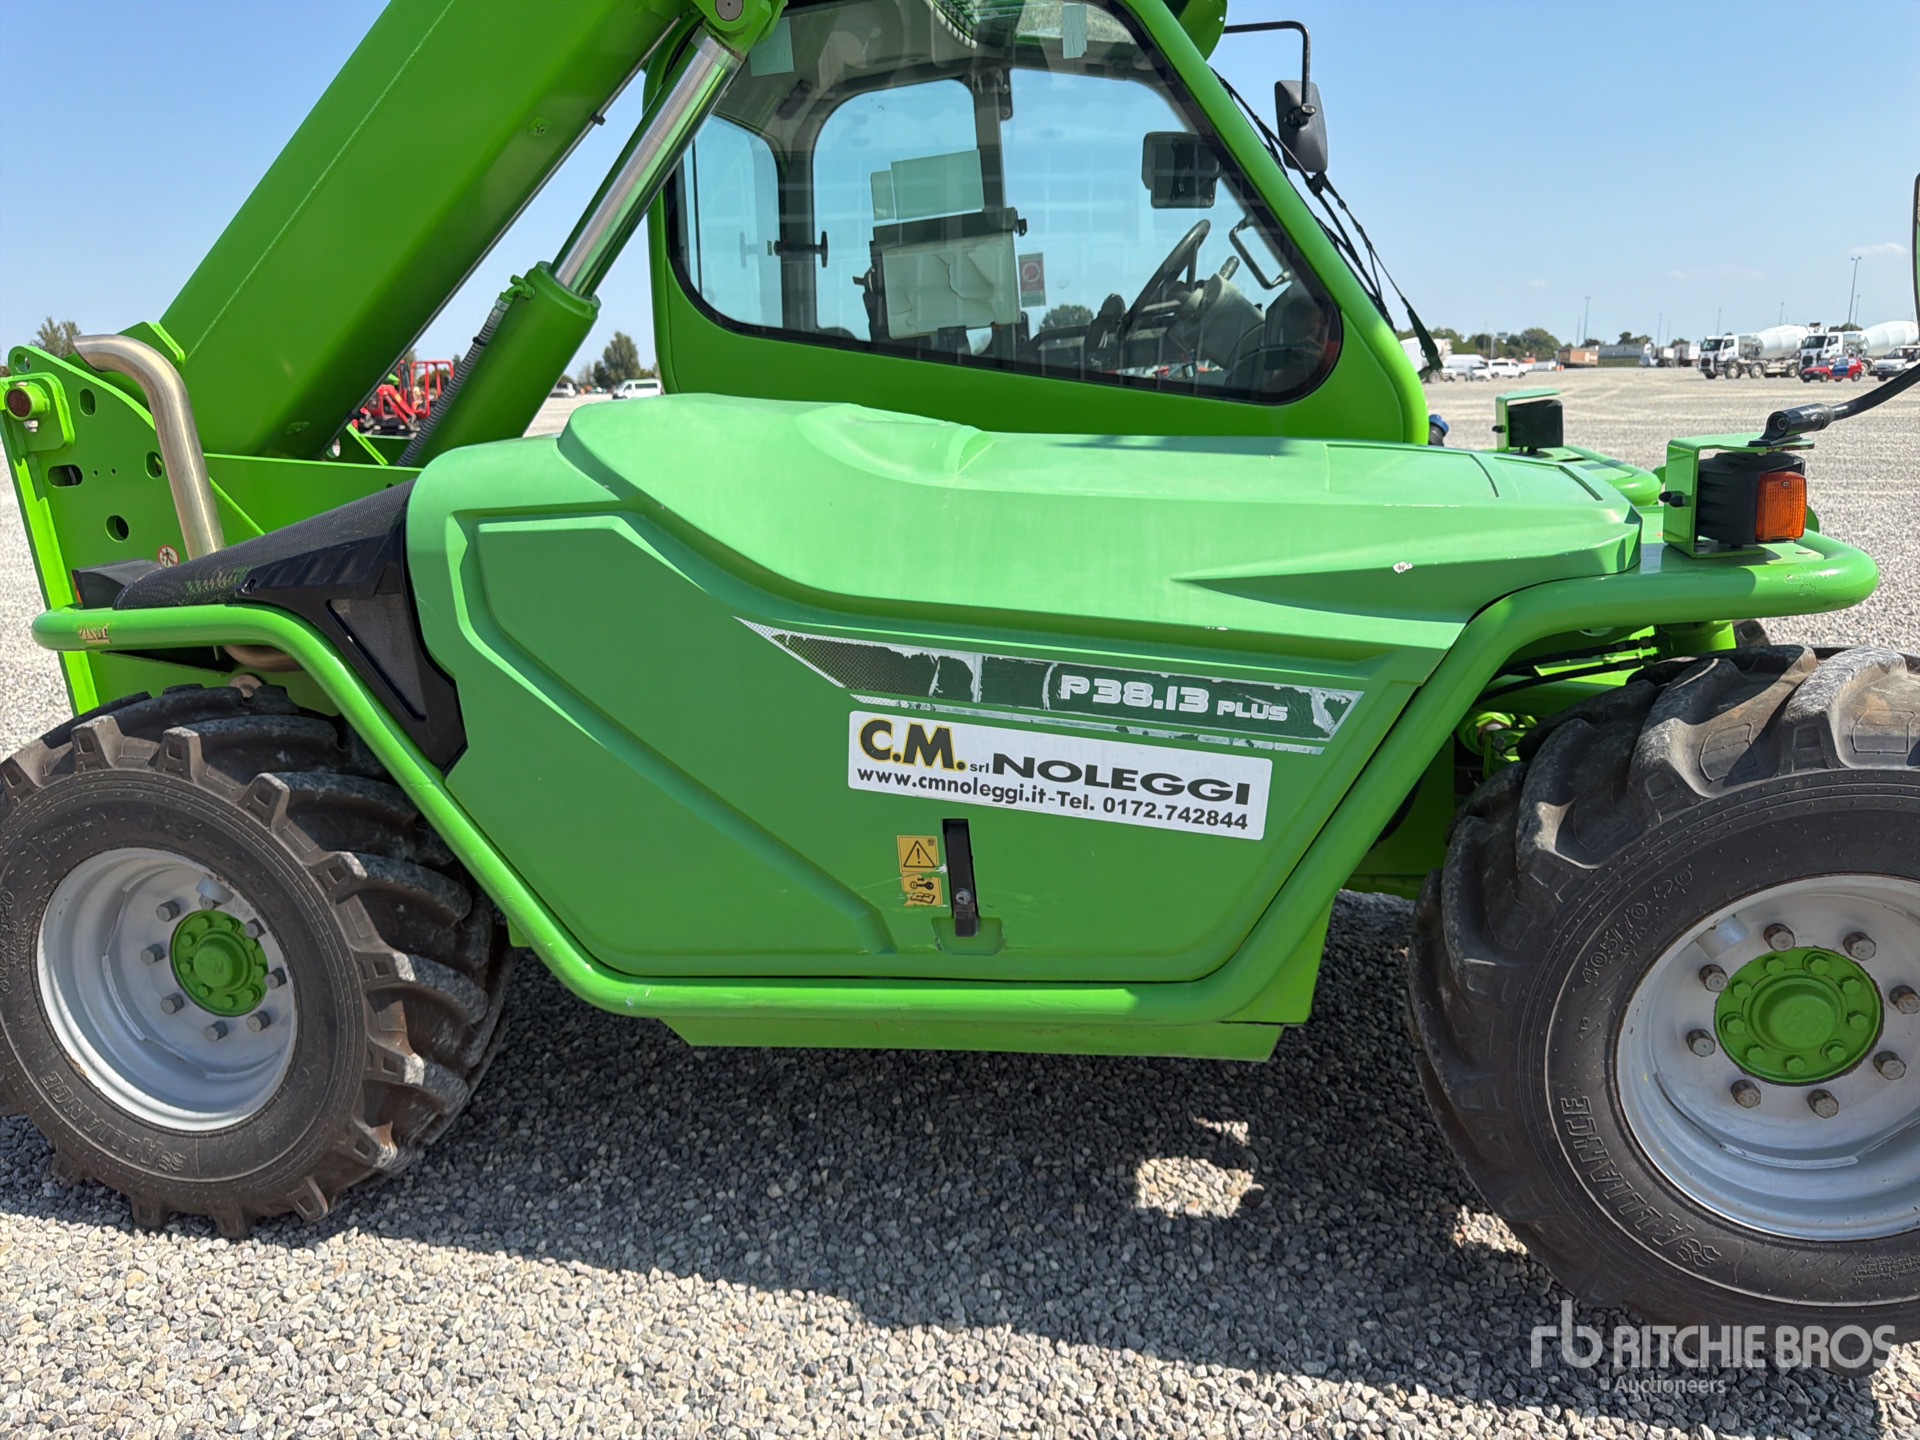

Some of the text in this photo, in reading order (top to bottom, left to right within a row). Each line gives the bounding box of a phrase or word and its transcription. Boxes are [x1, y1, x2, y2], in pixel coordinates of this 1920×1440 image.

[1060, 675, 1288, 722] P38.13 PLUS
[858, 717, 1251, 806] C.M. srl NOLEGGI
[1102, 796, 1249, 830] 0172.742844
[39, 1070, 164, 1165] ALLIANCE
[1560, 1095, 1696, 1247] ALLIANCE
